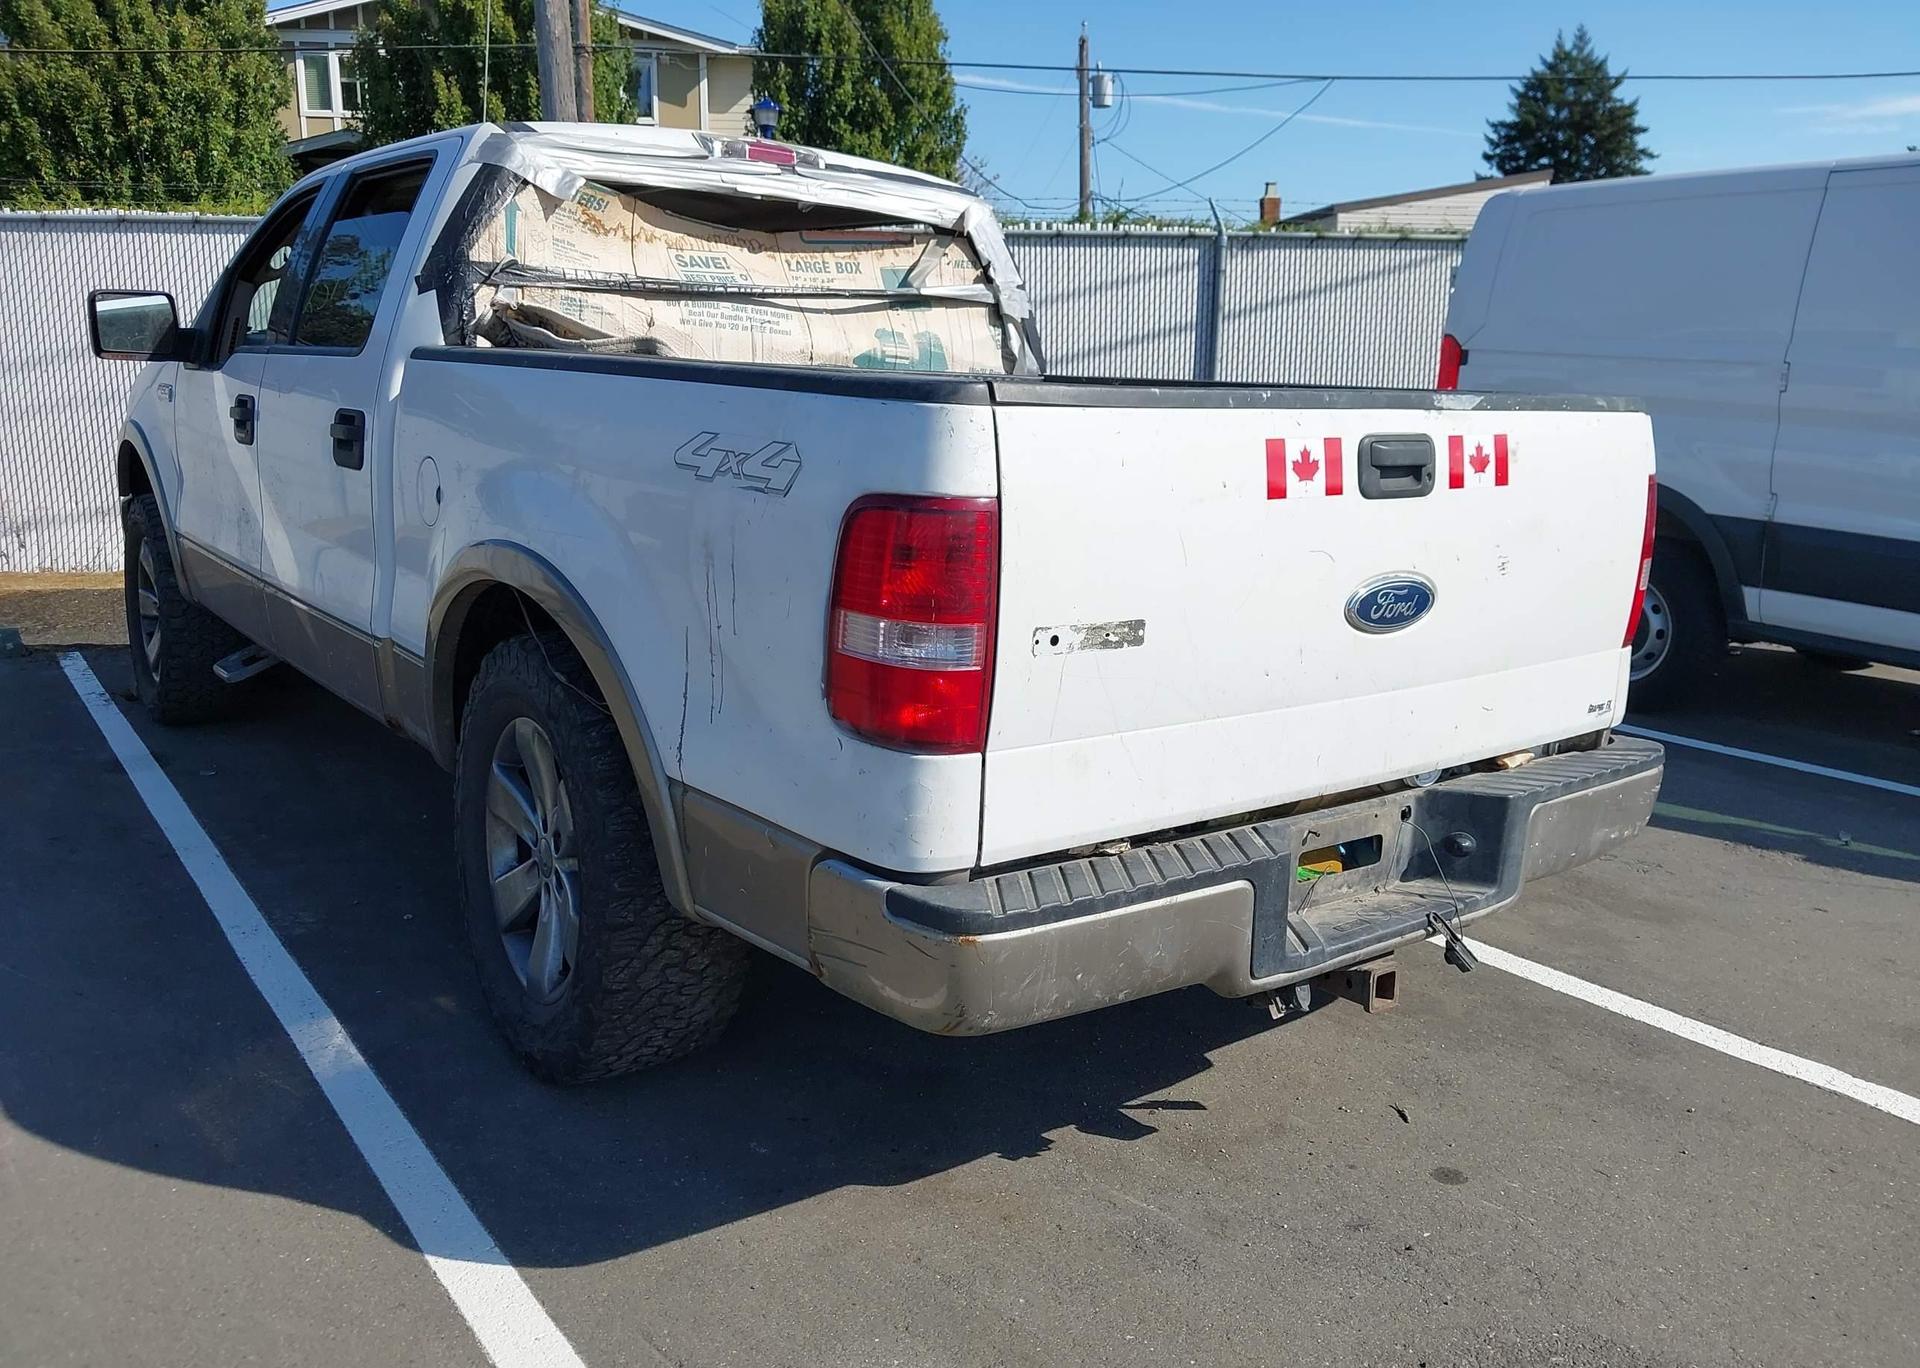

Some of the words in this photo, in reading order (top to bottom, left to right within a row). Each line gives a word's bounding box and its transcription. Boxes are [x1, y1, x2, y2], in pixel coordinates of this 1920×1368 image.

[674, 253, 731, 270] SAVE!
[786, 259, 832, 274] LARGE
[835, 261, 862, 274] BOX
[683, 273, 708, 282] BEST
[710, 274, 738, 284] PRICE
[688, 309, 705, 318] Beat
[706, 310, 718, 318] Our
[720, 312, 744, 321] Bundle
[691, 300, 721, 309] BUNDLE
[731, 304, 749, 313] SAVE
[751, 307, 769, 316] EVEN
[770, 310, 793, 320] MORE!
[680, 317, 697, 325] We'll
[698, 318, 713, 327] Give
[715, 320, 727, 330] You
[727, 322, 740, 331] $20
[741, 323, 749, 332] in
[751, 324, 767, 334] FREE
[768, 326, 792, 337] Boxes!
[673, 430, 802, 498] 4x4
[1370, 587, 1420, 620] Ford
